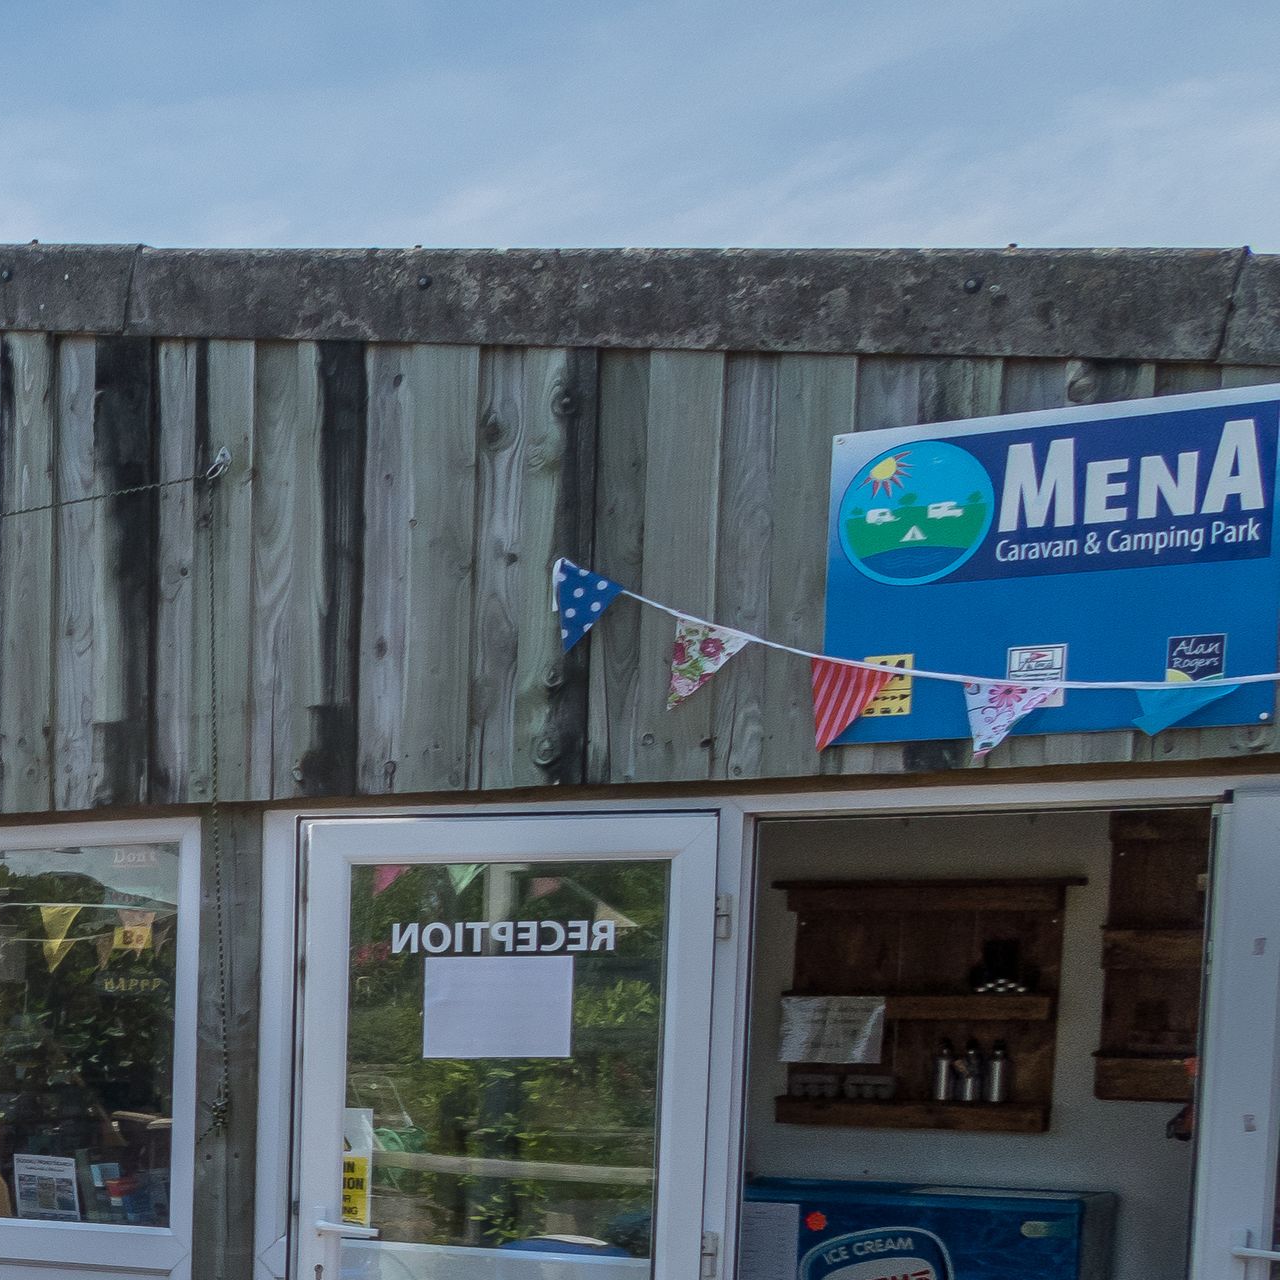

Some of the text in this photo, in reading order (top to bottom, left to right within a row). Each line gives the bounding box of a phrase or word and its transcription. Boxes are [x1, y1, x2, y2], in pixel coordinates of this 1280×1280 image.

[997, 418, 1266, 533] MENA
[995, 517, 1263, 562] Caravan & Camping Park
[1172, 638, 1221, 656] Alan
[1172, 656, 1220, 674] Rogers
[122, 929, 144, 945] Be
[823, 1236, 915, 1265] ICE CREAM
